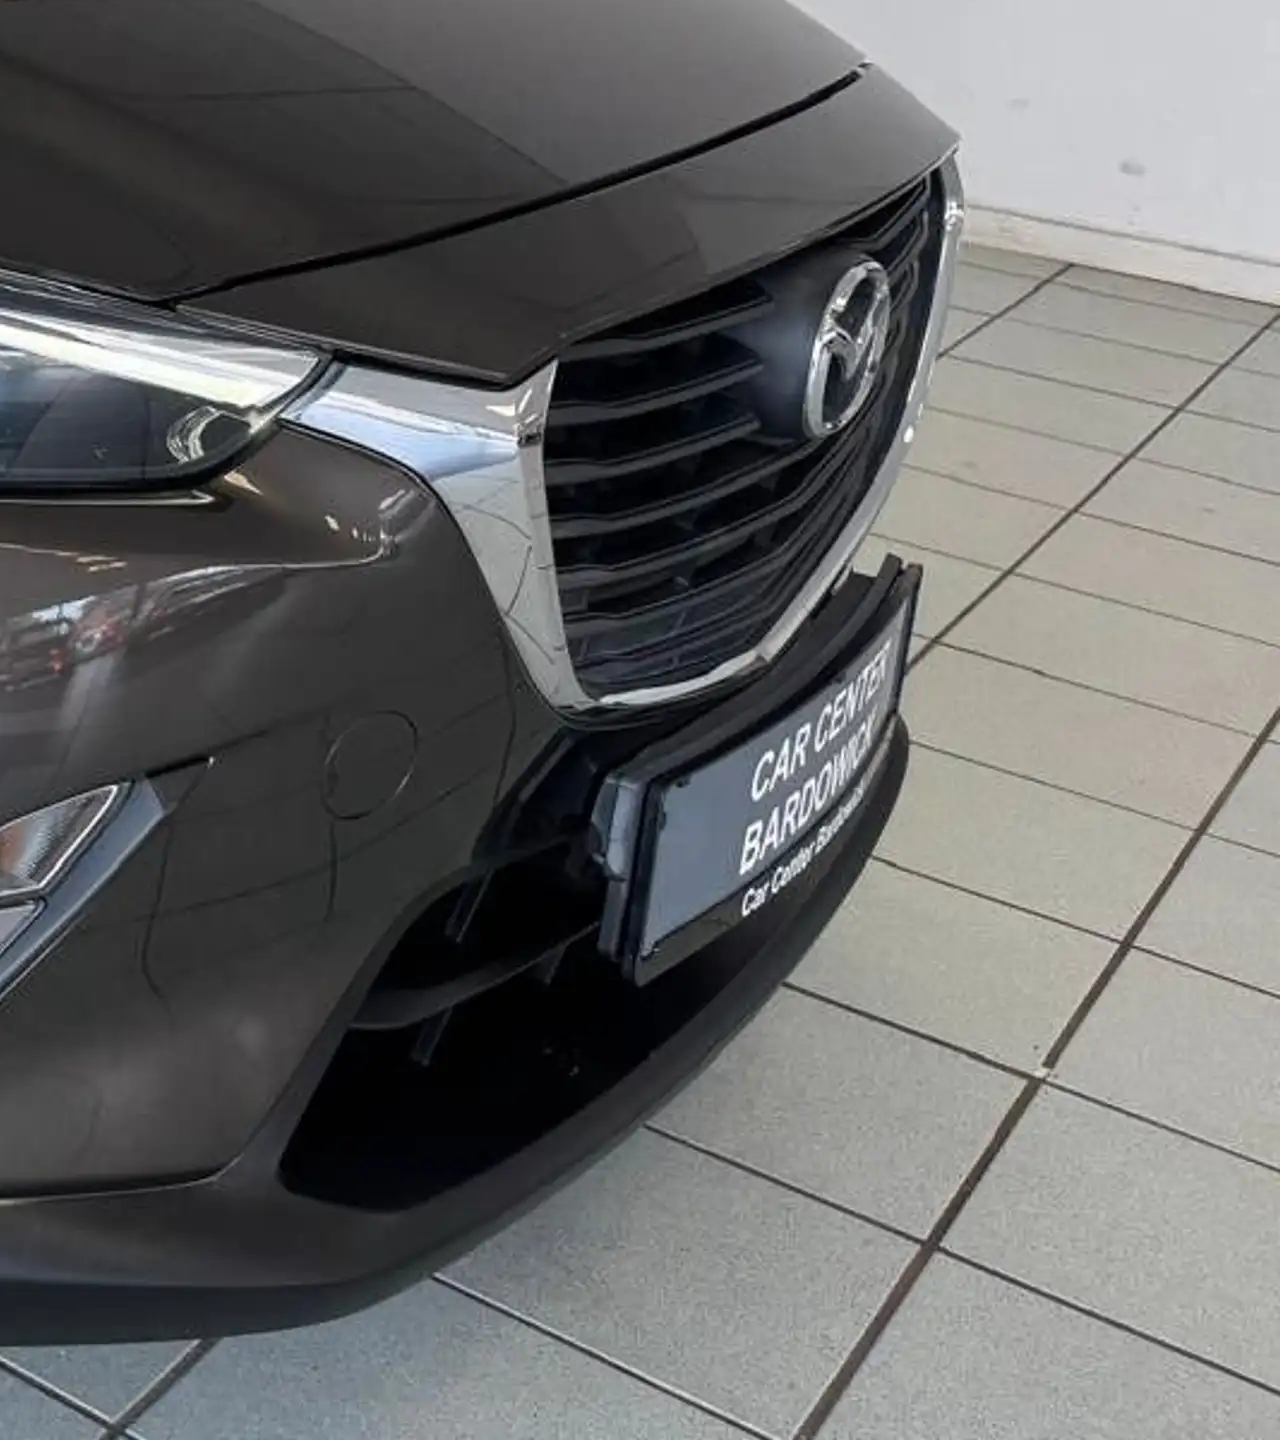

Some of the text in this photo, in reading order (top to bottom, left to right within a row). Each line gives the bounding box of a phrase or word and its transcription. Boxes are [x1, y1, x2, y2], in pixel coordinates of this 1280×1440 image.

[751, 721, 812, 802] CAR
[814, 639, 892, 753] CENTER
[742, 882, 771, 917] Car
